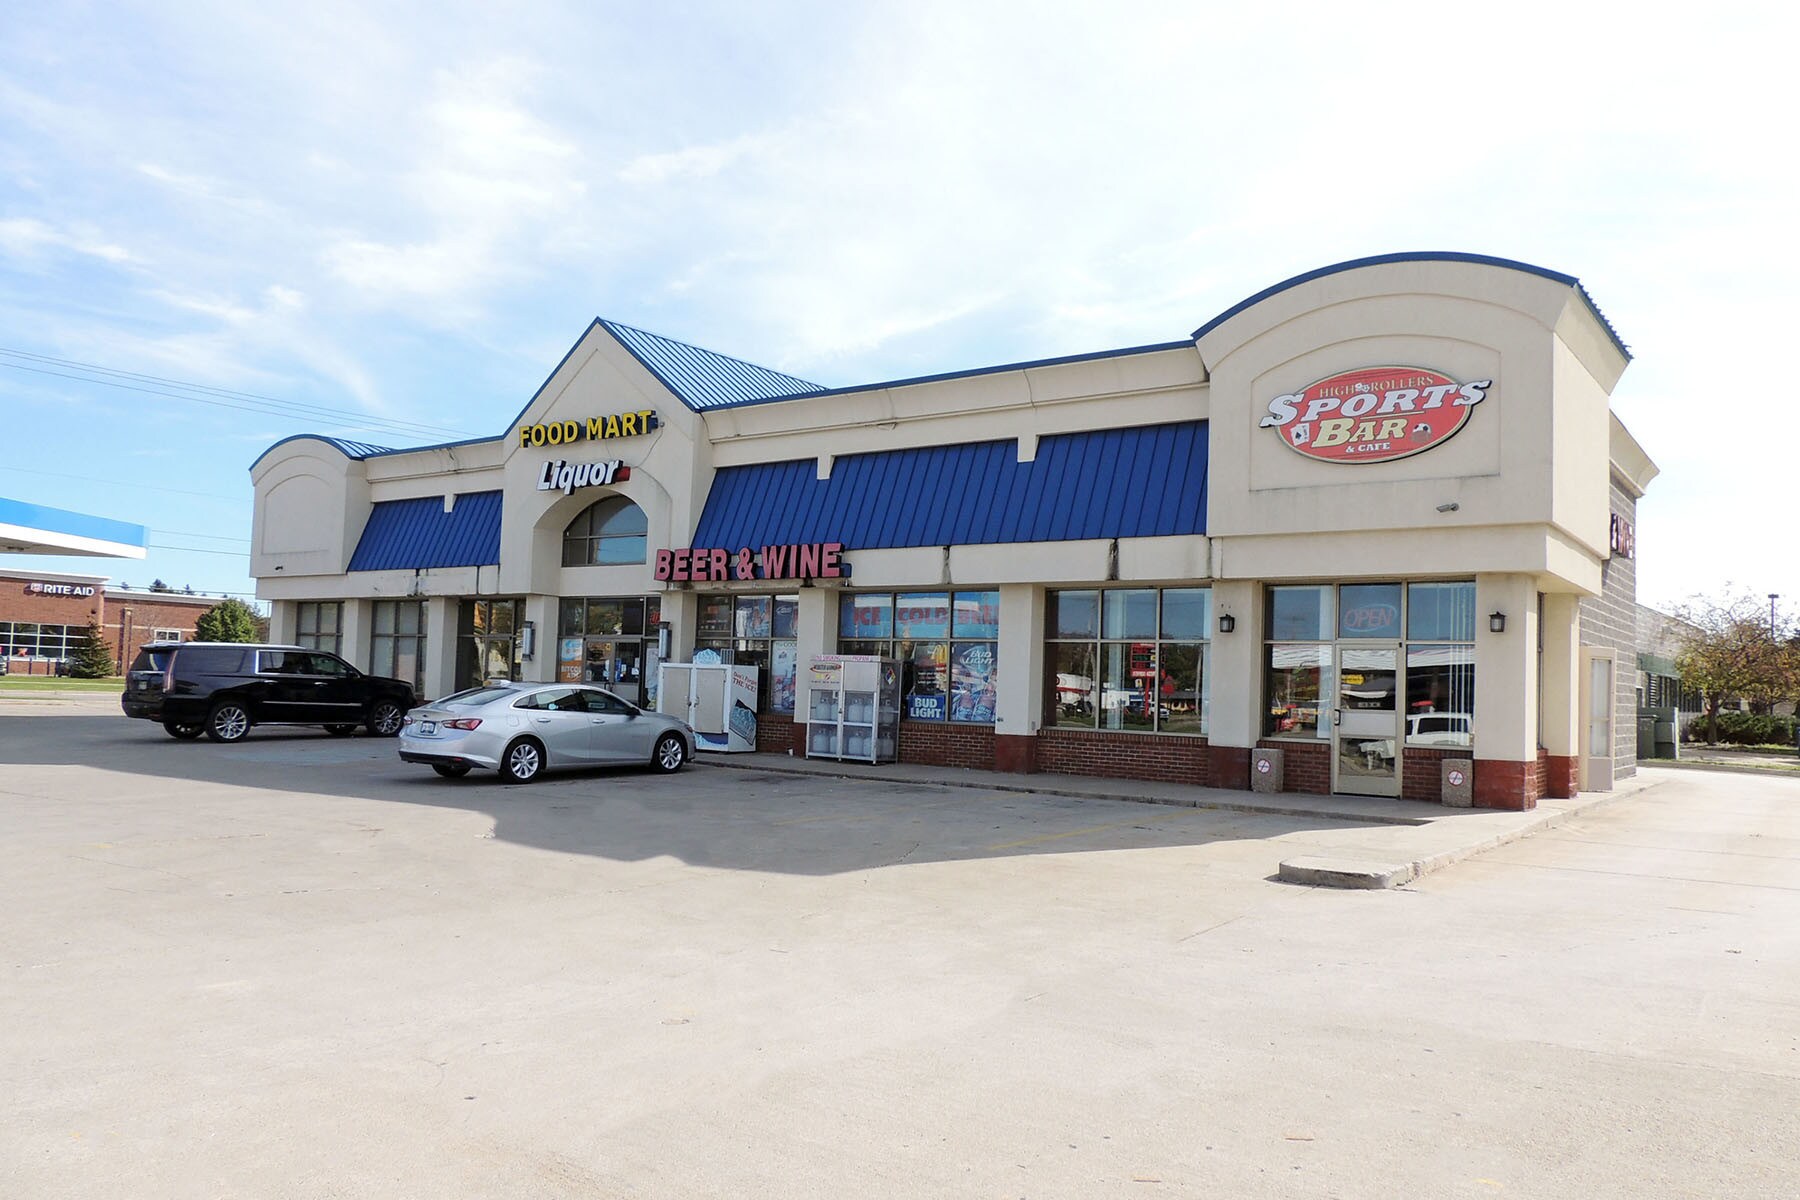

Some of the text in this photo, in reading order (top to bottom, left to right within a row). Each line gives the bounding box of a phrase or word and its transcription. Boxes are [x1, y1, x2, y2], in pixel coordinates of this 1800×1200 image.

[1320, 376, 1434, 398] HIGH ROLLERS
[1259, 380, 1491, 428] SPORTS
[519, 410, 652, 448] FOOD MART
[1312, 418, 1408, 448] BAR
[1346, 442, 1391, 453] & CAFE
[537, 460, 621, 495] Liquor
[654, 543, 842, 581] BEER & WINE
[44, 584, 71, 595] RITE
[73, 586, 95, 597] AID
[854, 606, 880, 625] ICE
[898, 606, 949, 625] COLD
[1345, 608, 1392, 627] OPEN
[965, 657, 994, 665] LIGHT
[970, 650, 992, 658] BUD
[914, 697, 938, 708] BUD
[910, 707, 942, 719] LIGHT
